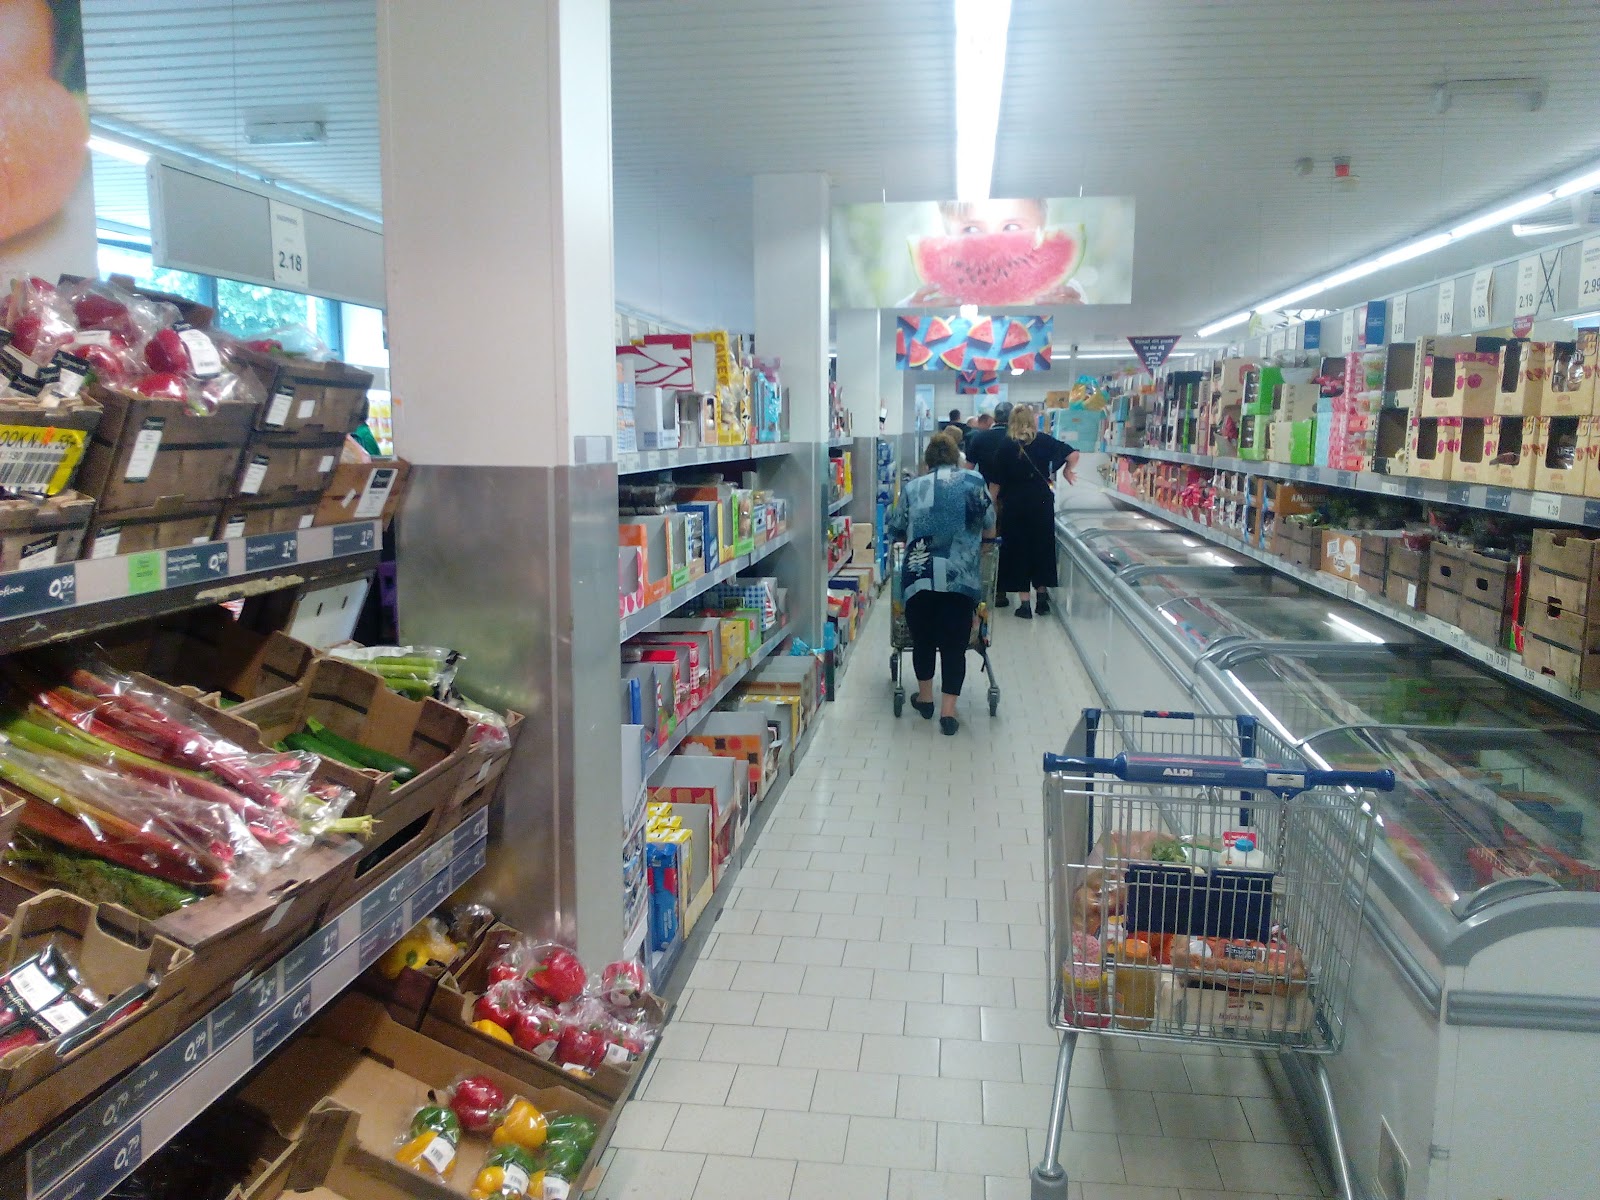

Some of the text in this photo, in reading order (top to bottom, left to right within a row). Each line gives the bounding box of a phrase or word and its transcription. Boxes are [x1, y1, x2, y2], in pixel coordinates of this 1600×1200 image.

[279, 251, 302, 271] 2.18
[1519, 293, 1534, 308] 2.19
[1162, 767, 1194, 777] ALDI
